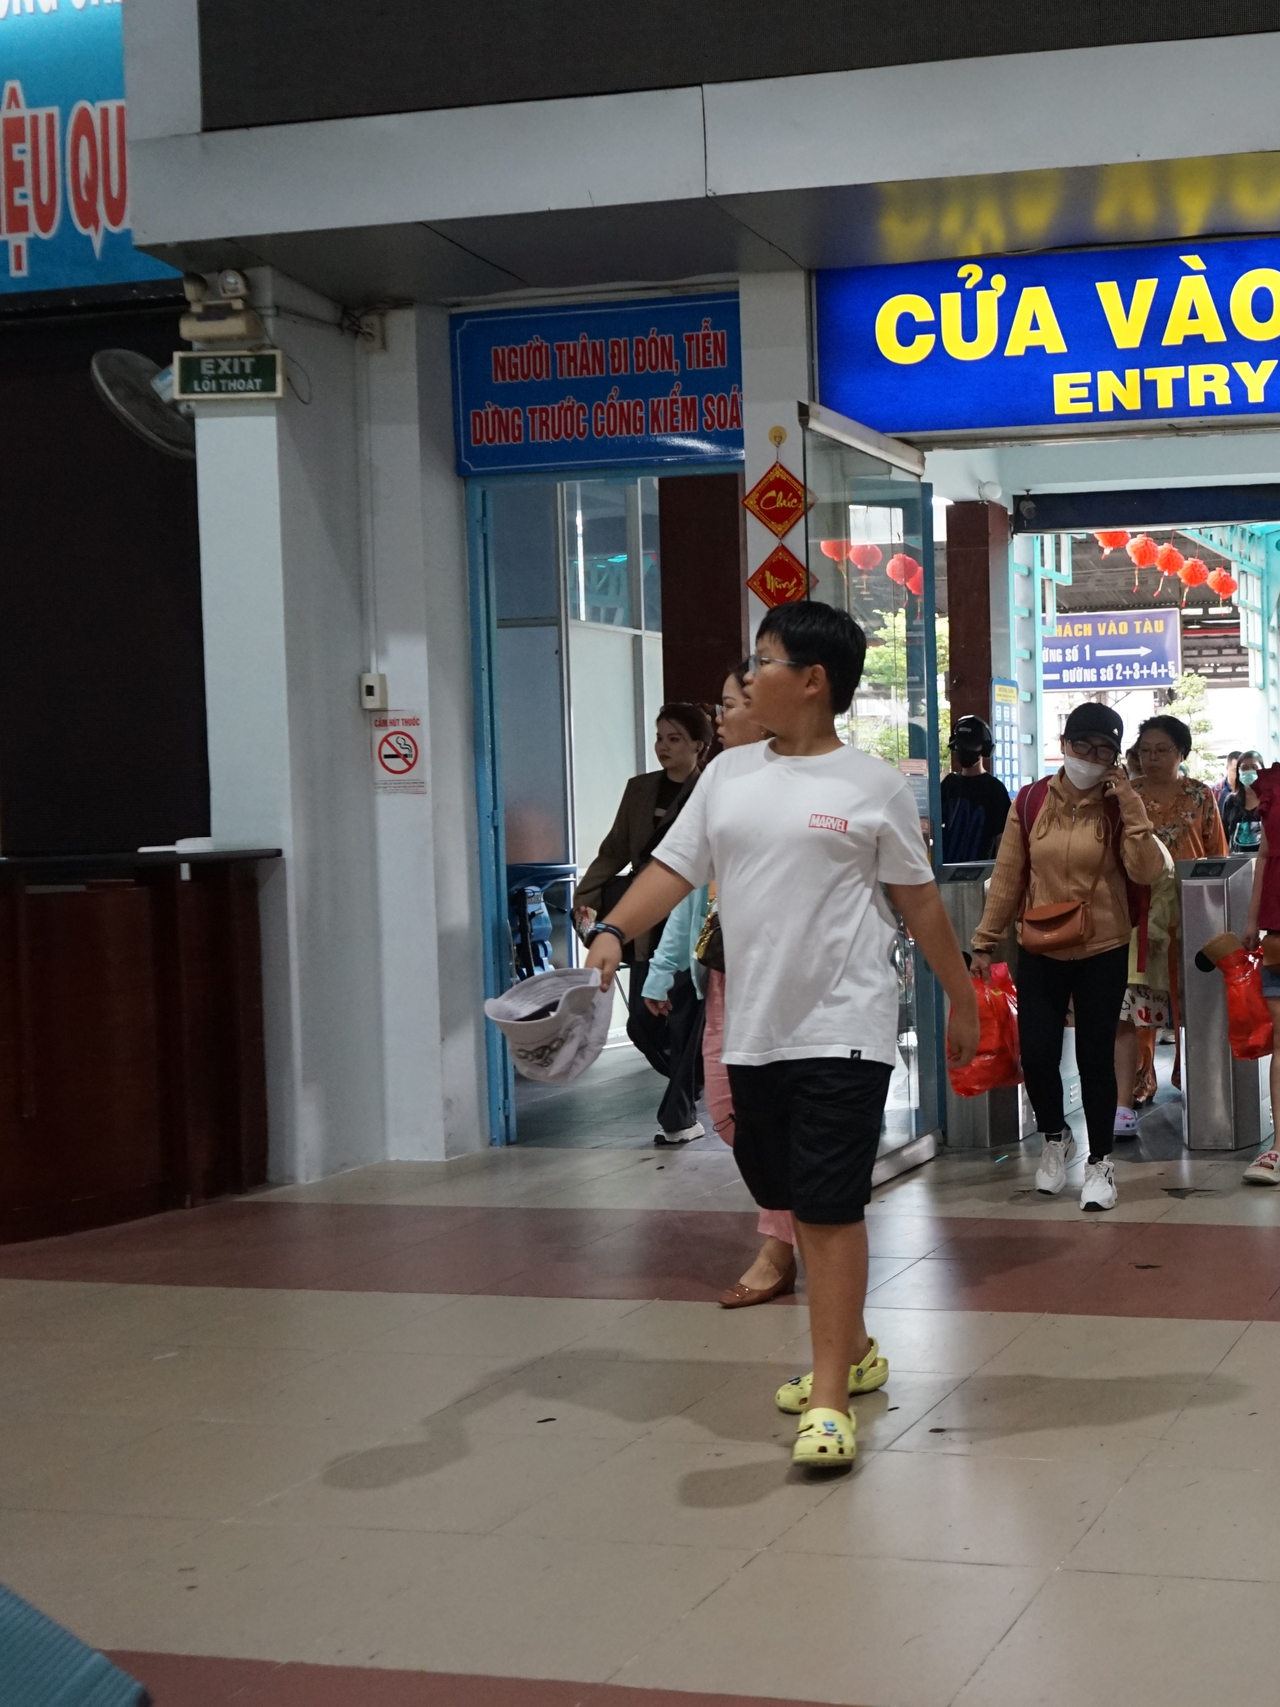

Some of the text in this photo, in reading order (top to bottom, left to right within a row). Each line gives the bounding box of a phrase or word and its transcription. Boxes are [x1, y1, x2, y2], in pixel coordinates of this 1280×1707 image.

[0, 79, 61, 277] ỆU
[875, 263, 1068, 364] CỬA
[491, 317, 727, 383] NGƯỜI THÂN ĐI ĐÓN, TIỄN
[200, 356, 256, 375] EXIT
[1053, 359, 1279, 415] ENTRY
[470, 381, 744, 446] DỪNG TRƯỚC CỔNG KIỂM SOÁ
[760, 489, 798, 510] Chúc
[1045, 617, 1164, 638] HÁCH VÀO TÀU
[1042, 643, 1091, 663] ỜNG SỐ 1
[1062, 666, 1098, 683] ĐƯỜNG
[1100, 663, 1115, 682] SỐ
[808, 814, 848, 834] MARVEL
